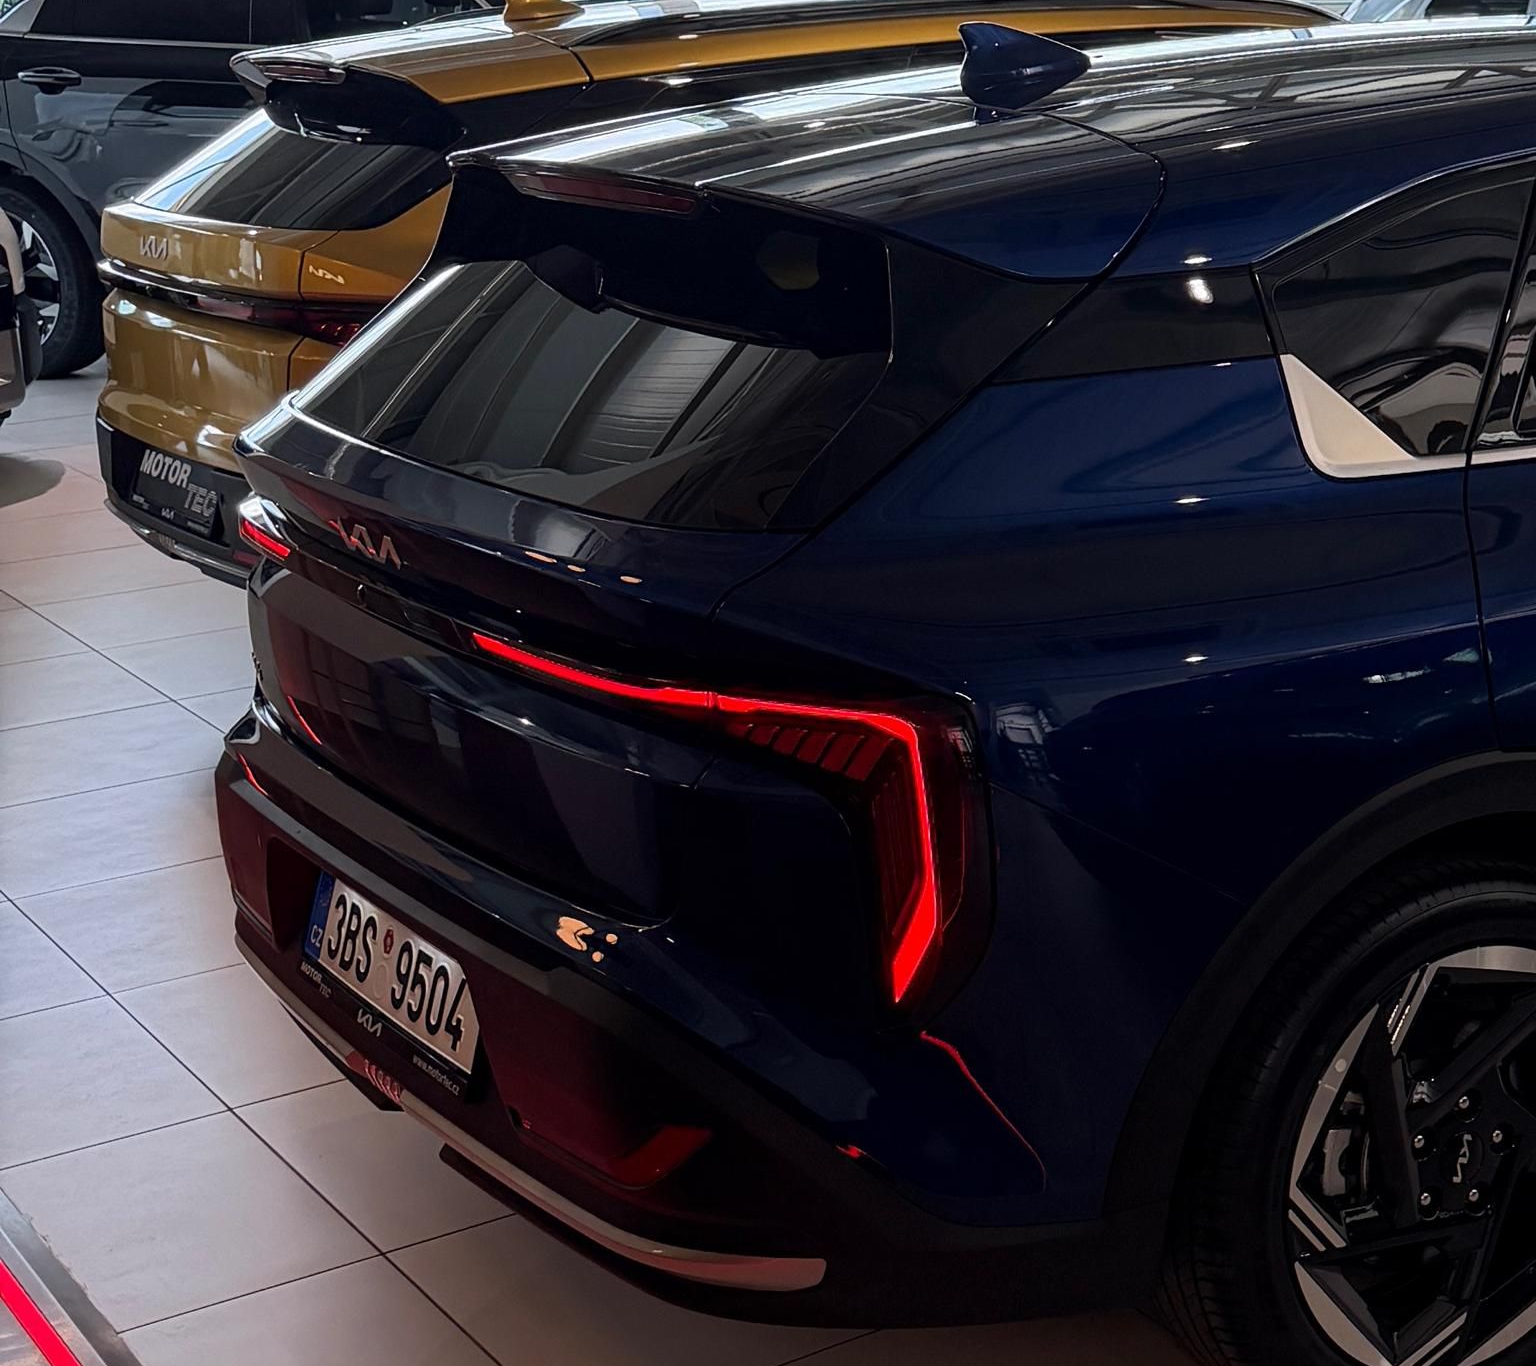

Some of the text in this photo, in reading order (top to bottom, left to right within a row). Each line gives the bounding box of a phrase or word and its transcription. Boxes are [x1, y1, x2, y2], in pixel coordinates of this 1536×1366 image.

[140, 449, 192, 489] MOTOR
[184, 483, 217, 517] TEC
[311, 924, 324, 948] CZ
[300, 961, 322, 984] MOTOR
[327, 894, 467, 1053] 3BS 9504
